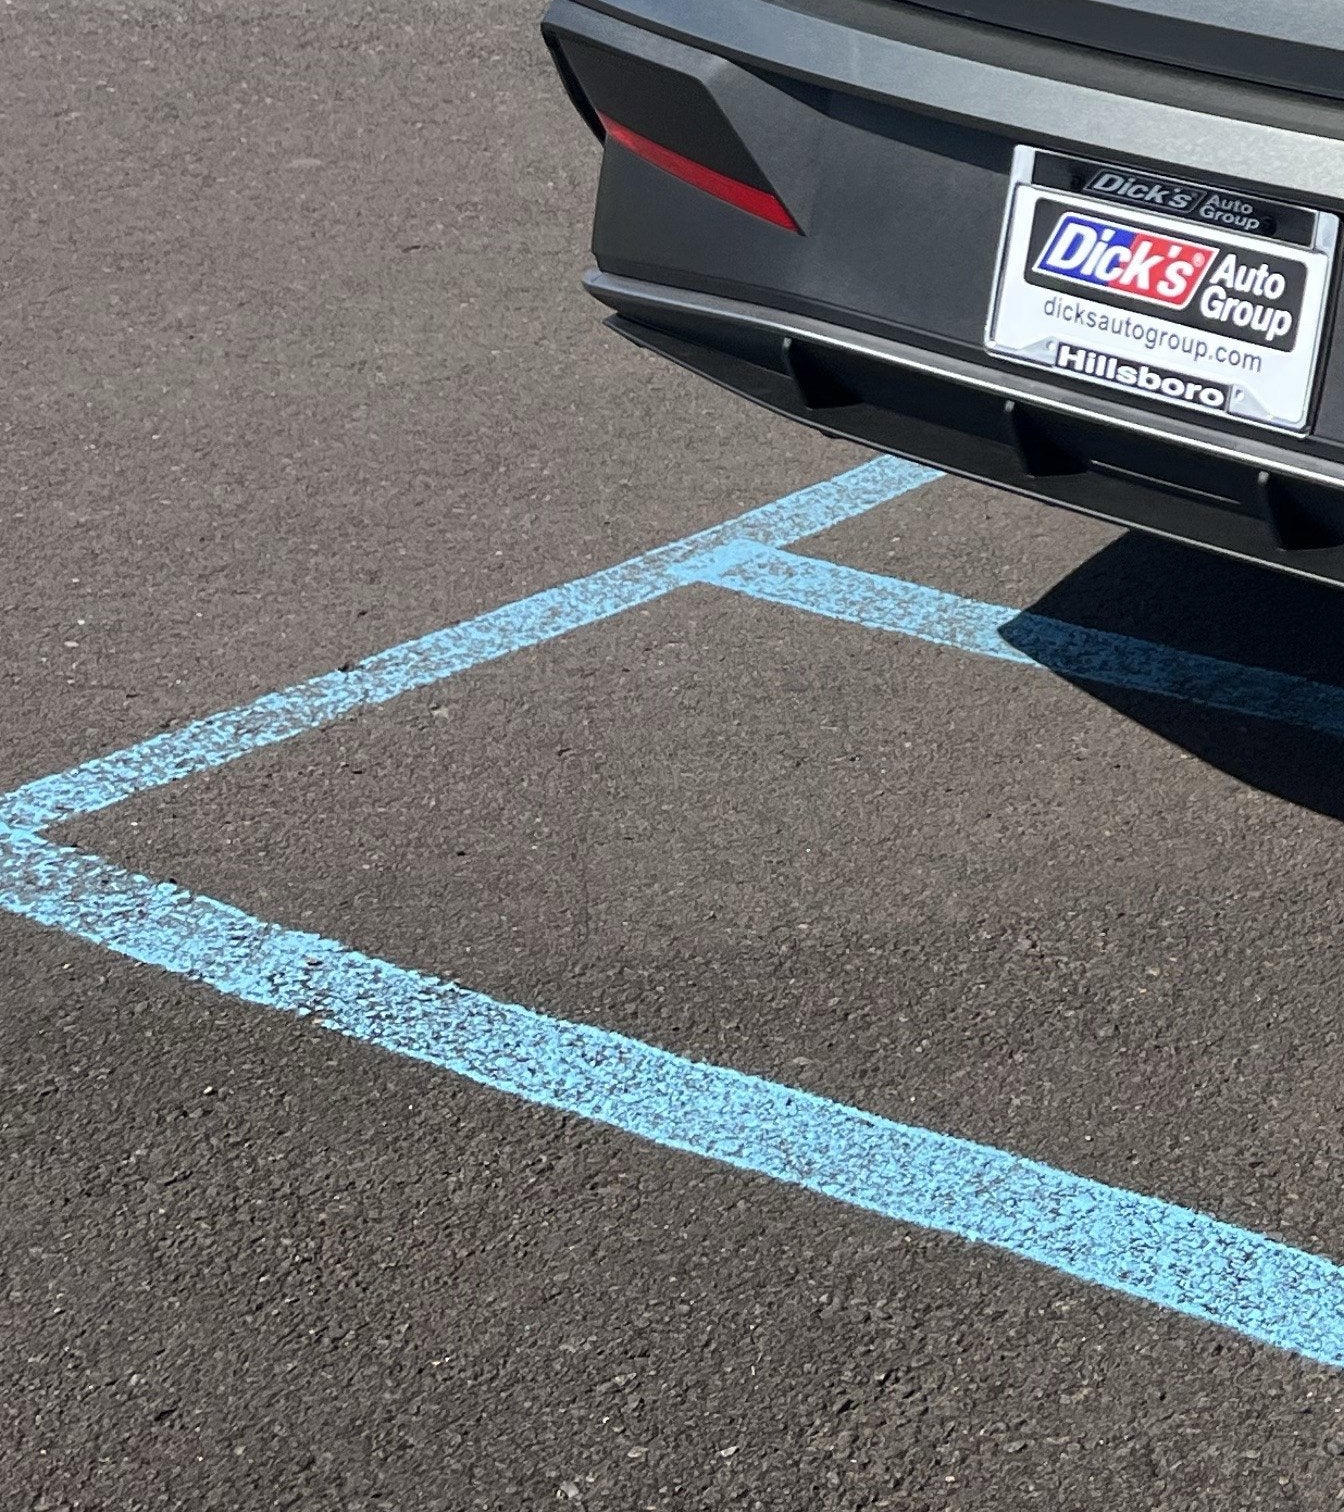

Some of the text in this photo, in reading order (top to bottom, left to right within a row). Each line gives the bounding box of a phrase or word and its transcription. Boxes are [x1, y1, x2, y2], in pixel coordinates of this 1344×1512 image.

[1092, 172, 1194, 210] Dick's
[1204, 194, 1254, 215] Auto
[1199, 206, 1261, 231] Group
[1209, 253, 1286, 301] Auto
[1043, 297, 1262, 373] dicksautogroup.com
[1199, 288, 1293, 341] Group
[1056, 343, 1226, 409] Hillsboro
